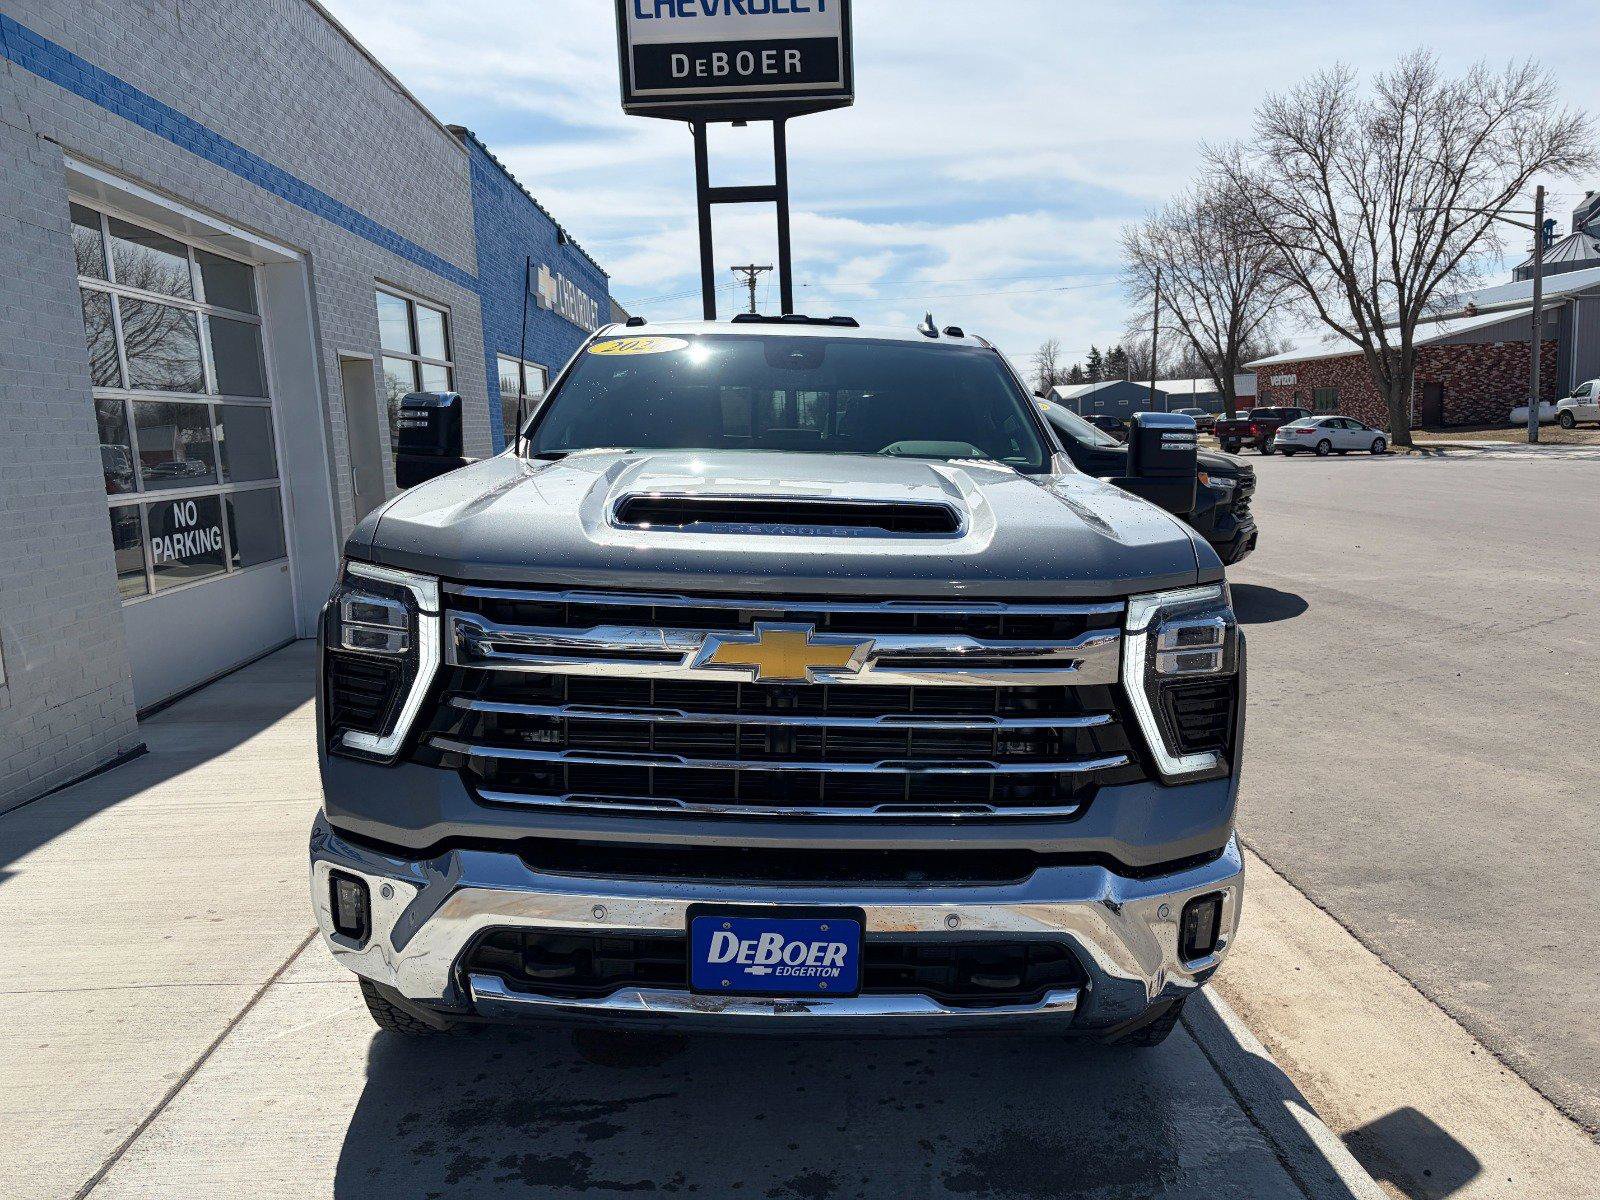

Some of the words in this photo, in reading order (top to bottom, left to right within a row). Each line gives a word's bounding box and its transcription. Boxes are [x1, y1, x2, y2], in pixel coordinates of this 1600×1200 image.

[600, 338, 667, 353] 202
[173, 500, 198, 528] NO
[152, 525, 222, 564] PARKING
[775, 966, 841, 978] EDGERTON
